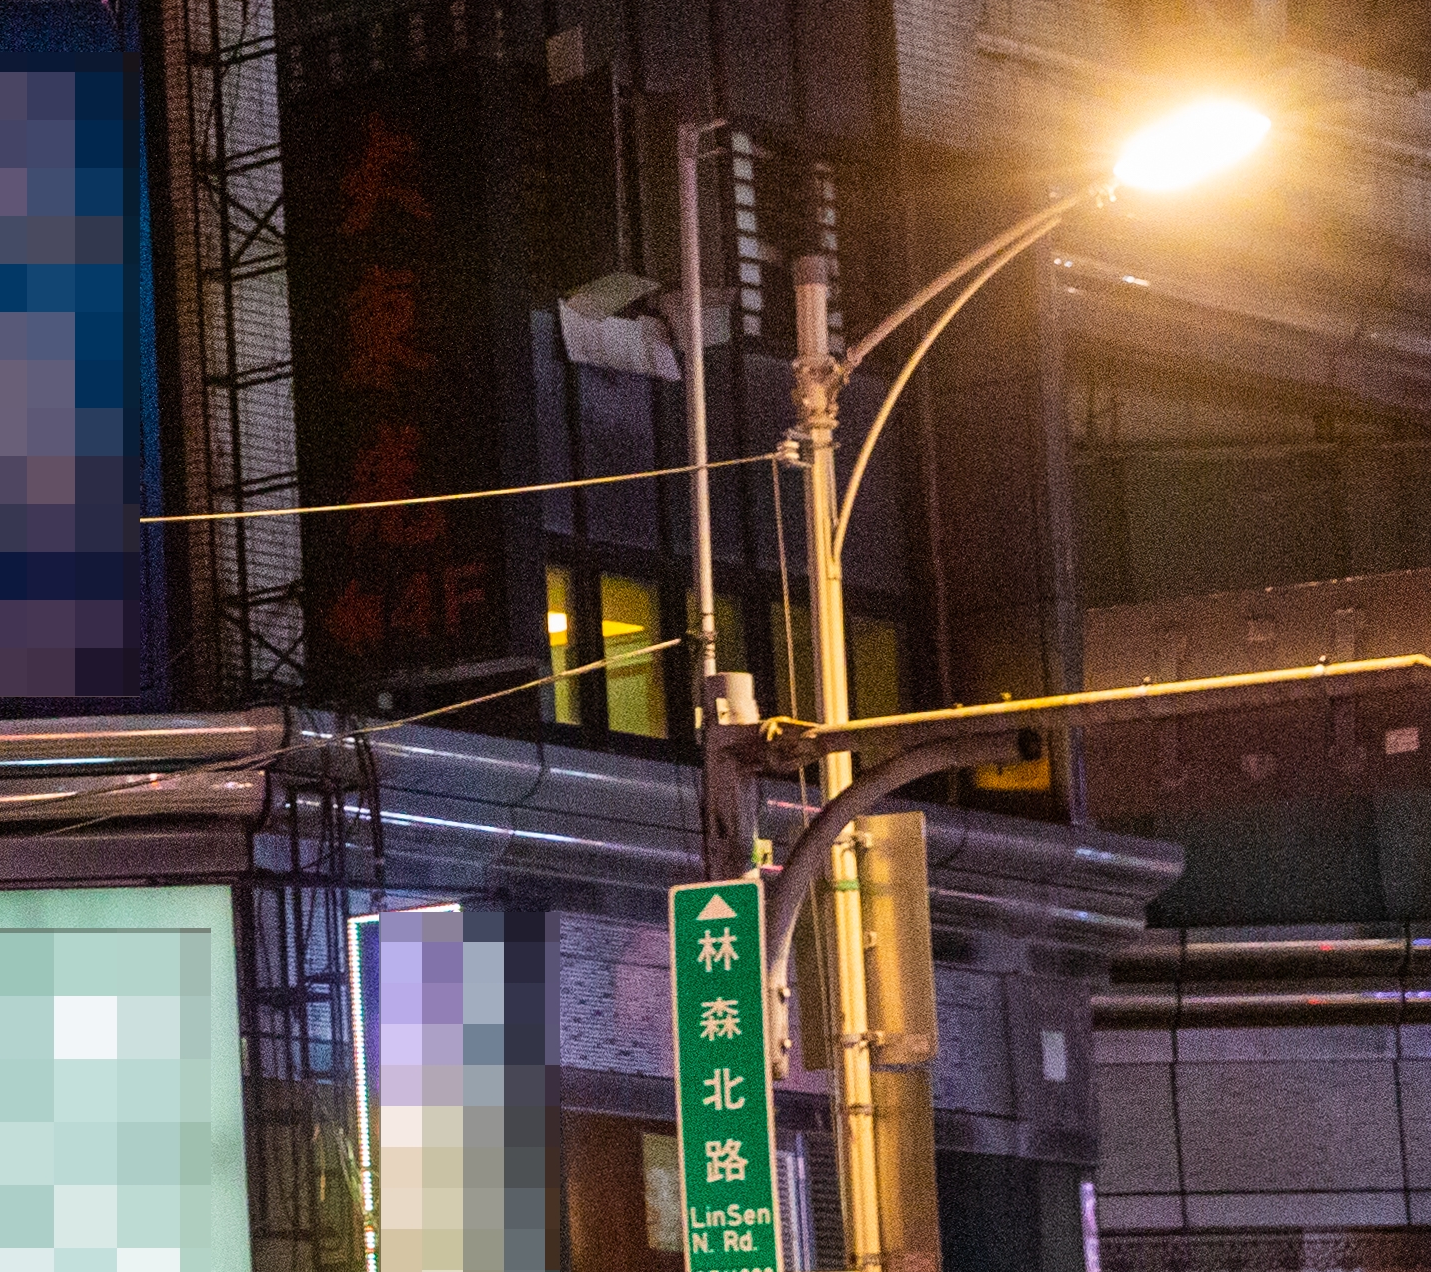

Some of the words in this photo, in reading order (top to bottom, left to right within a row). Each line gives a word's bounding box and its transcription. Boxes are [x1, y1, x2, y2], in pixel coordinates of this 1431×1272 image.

[697, 928, 749, 1184] 林森北路
[690, 1204, 772, 1230] LinSen
[692, 1230, 714, 1254] N.
[723, 1230, 758, 1254] Rd.
